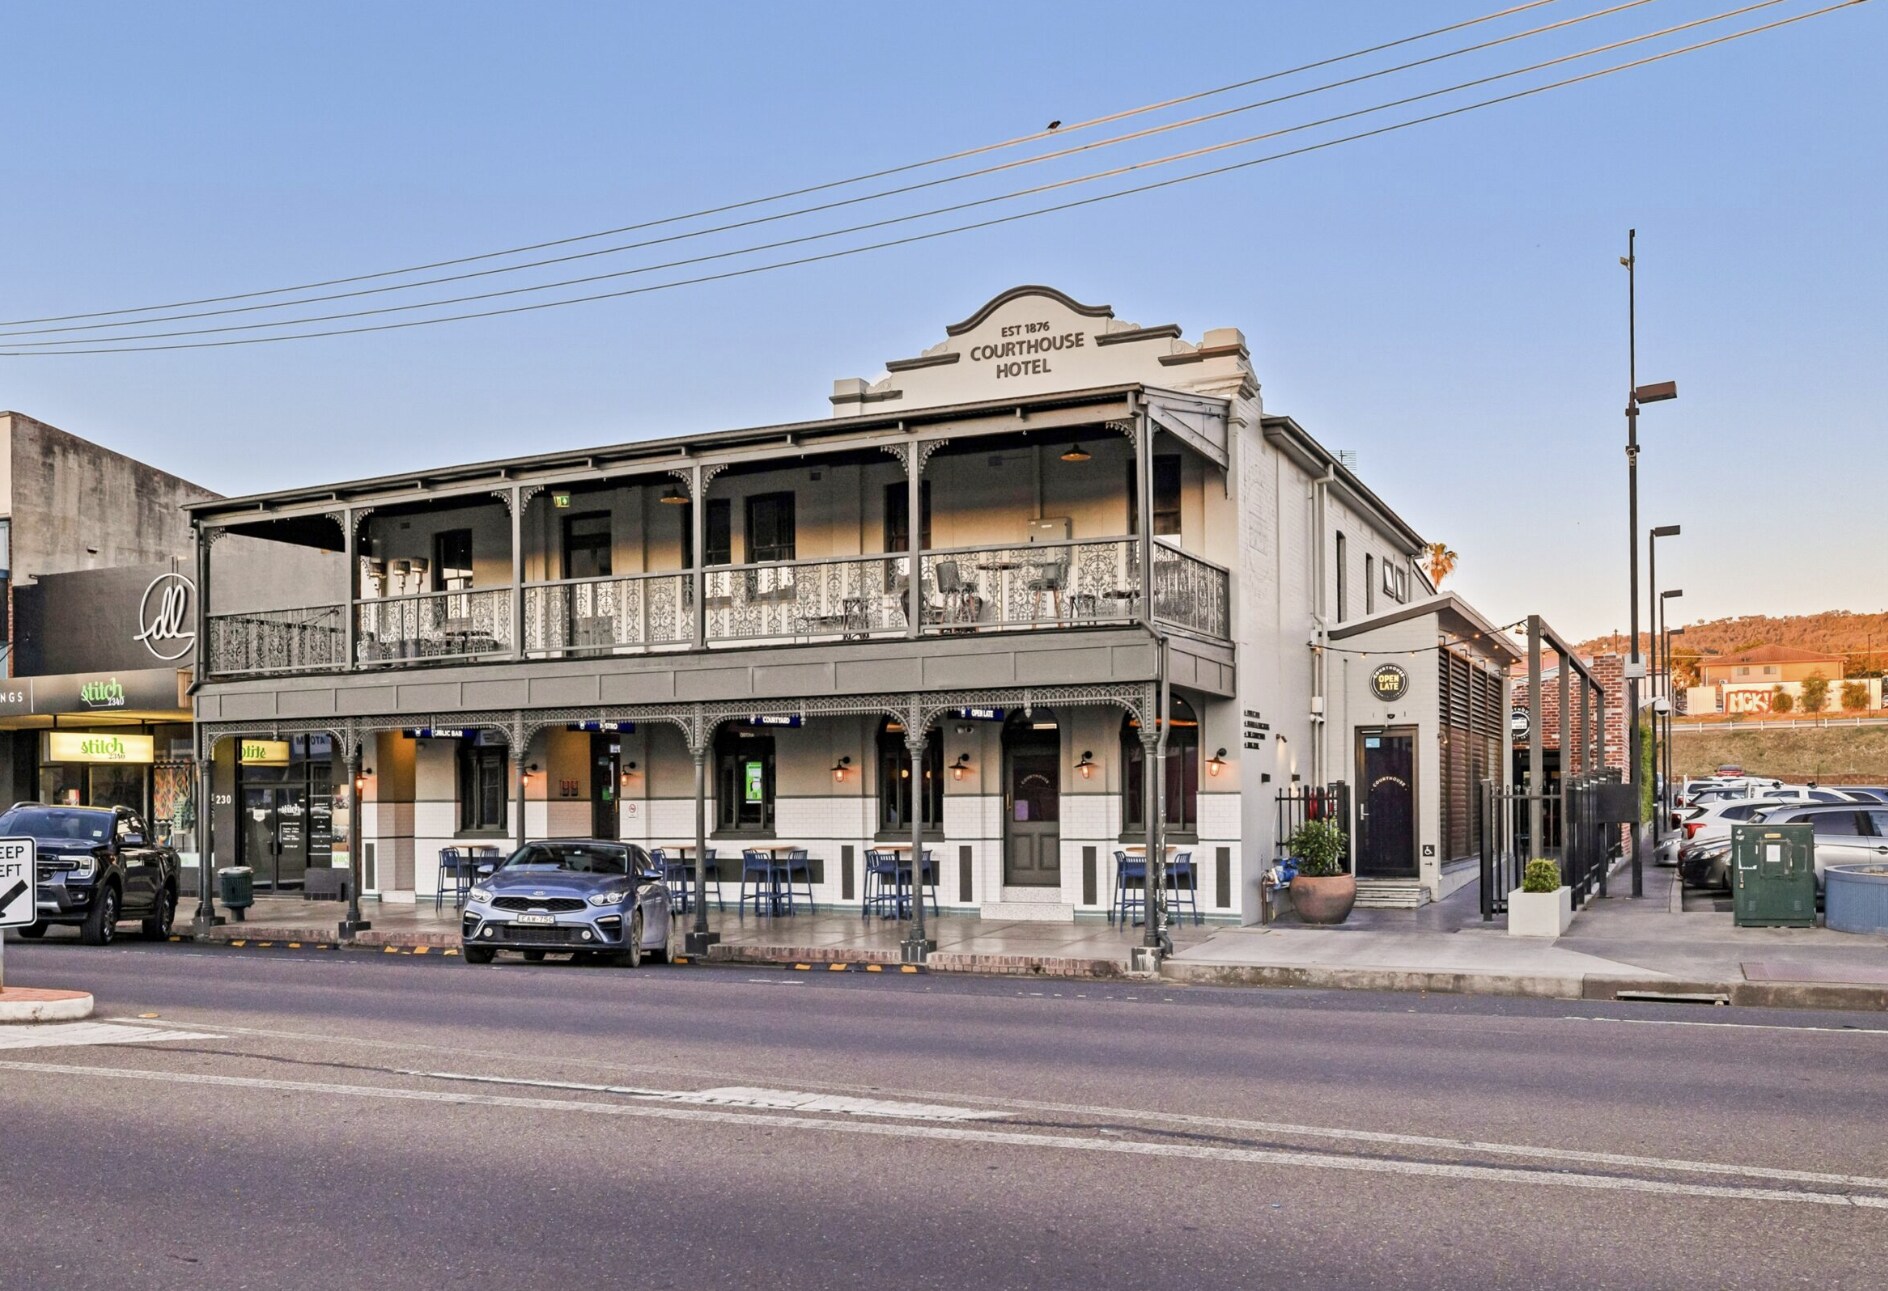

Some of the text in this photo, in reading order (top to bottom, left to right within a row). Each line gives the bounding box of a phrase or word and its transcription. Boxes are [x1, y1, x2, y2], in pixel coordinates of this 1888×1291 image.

[1001, 320, 1050, 338] EST 1876
[970, 331, 1085, 362] COURTHOUSE
[996, 358, 1052, 379] HOTEL
[1378, 674, 1400, 683] OPEN
[81, 677, 123, 701] stitch
[1379, 682, 1399, 691] LATE
[971, 708, 983, 718] OPEN
[762, 716, 791, 724] COURTYARD
[600, 722, 618, 730] BSTRO
[81, 736, 124, 755] stitch
[215, 794, 232, 805] 230
